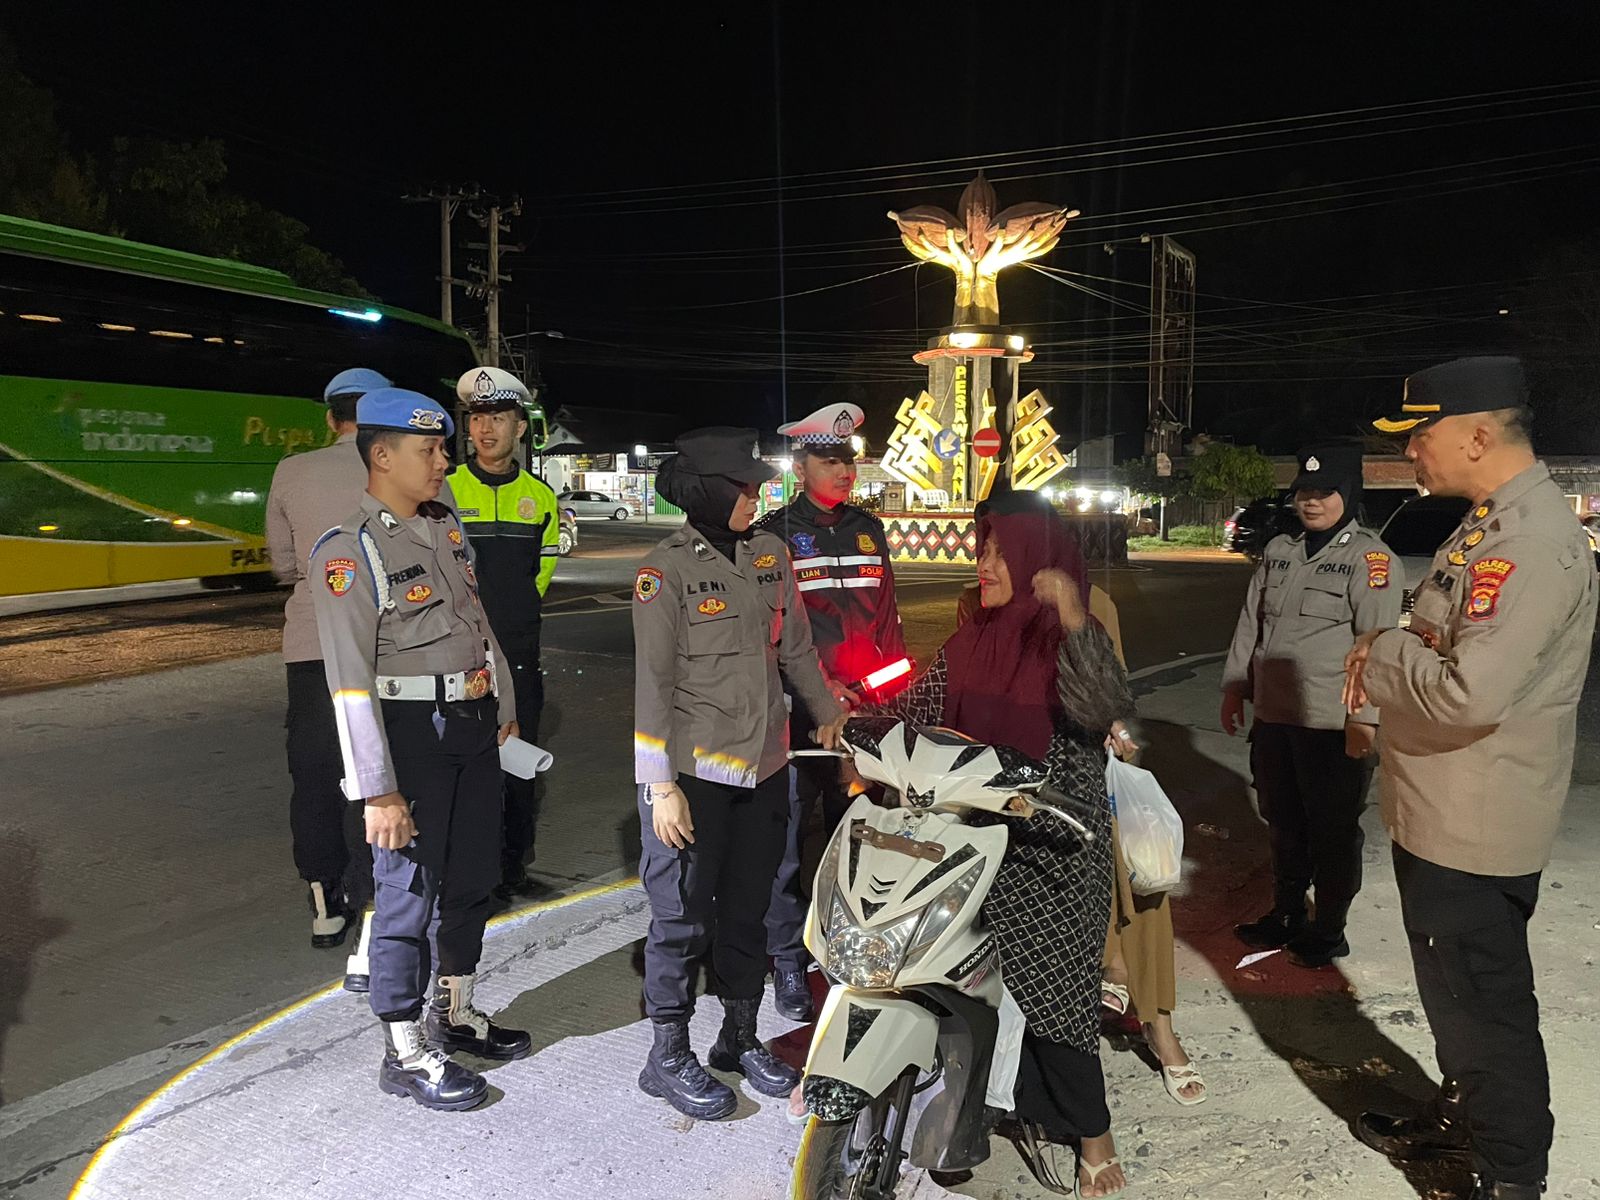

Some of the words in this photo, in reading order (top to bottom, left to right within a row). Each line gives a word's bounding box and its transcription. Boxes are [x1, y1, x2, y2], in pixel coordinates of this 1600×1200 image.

[1315, 563, 1352, 575] POLRI
[1473, 559, 1512, 572] POLRES
[801, 569, 821, 578] LIAN
[686, 581, 726, 595] LENI
